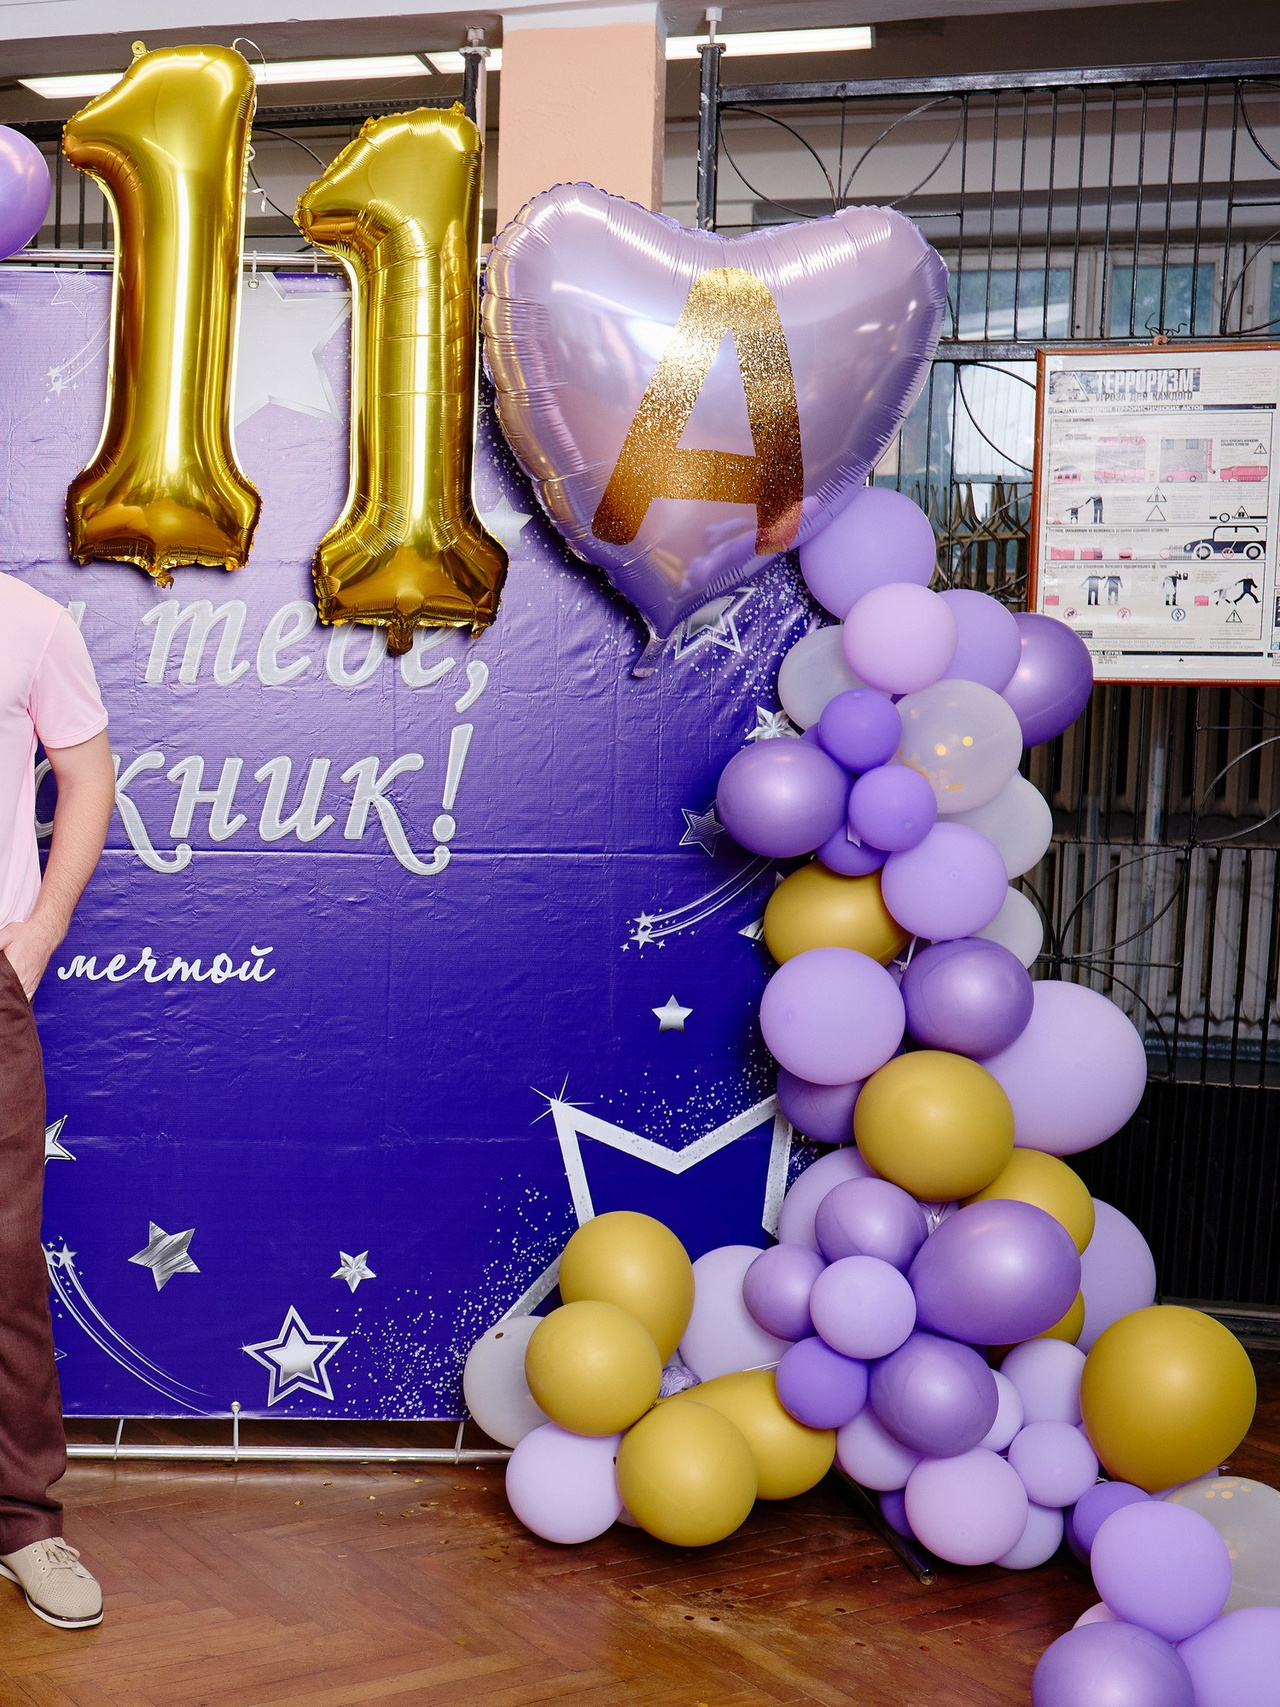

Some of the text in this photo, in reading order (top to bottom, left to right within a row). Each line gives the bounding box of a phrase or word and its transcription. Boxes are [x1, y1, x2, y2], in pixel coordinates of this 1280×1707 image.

[1096, 369, 1194, 392] ТЕРРОРИЗМ
[1096, 390, 1193, 402] УГРОЗА ДЛЯ КАЖДОГО
[57, 945, 276, 984] мечтой
